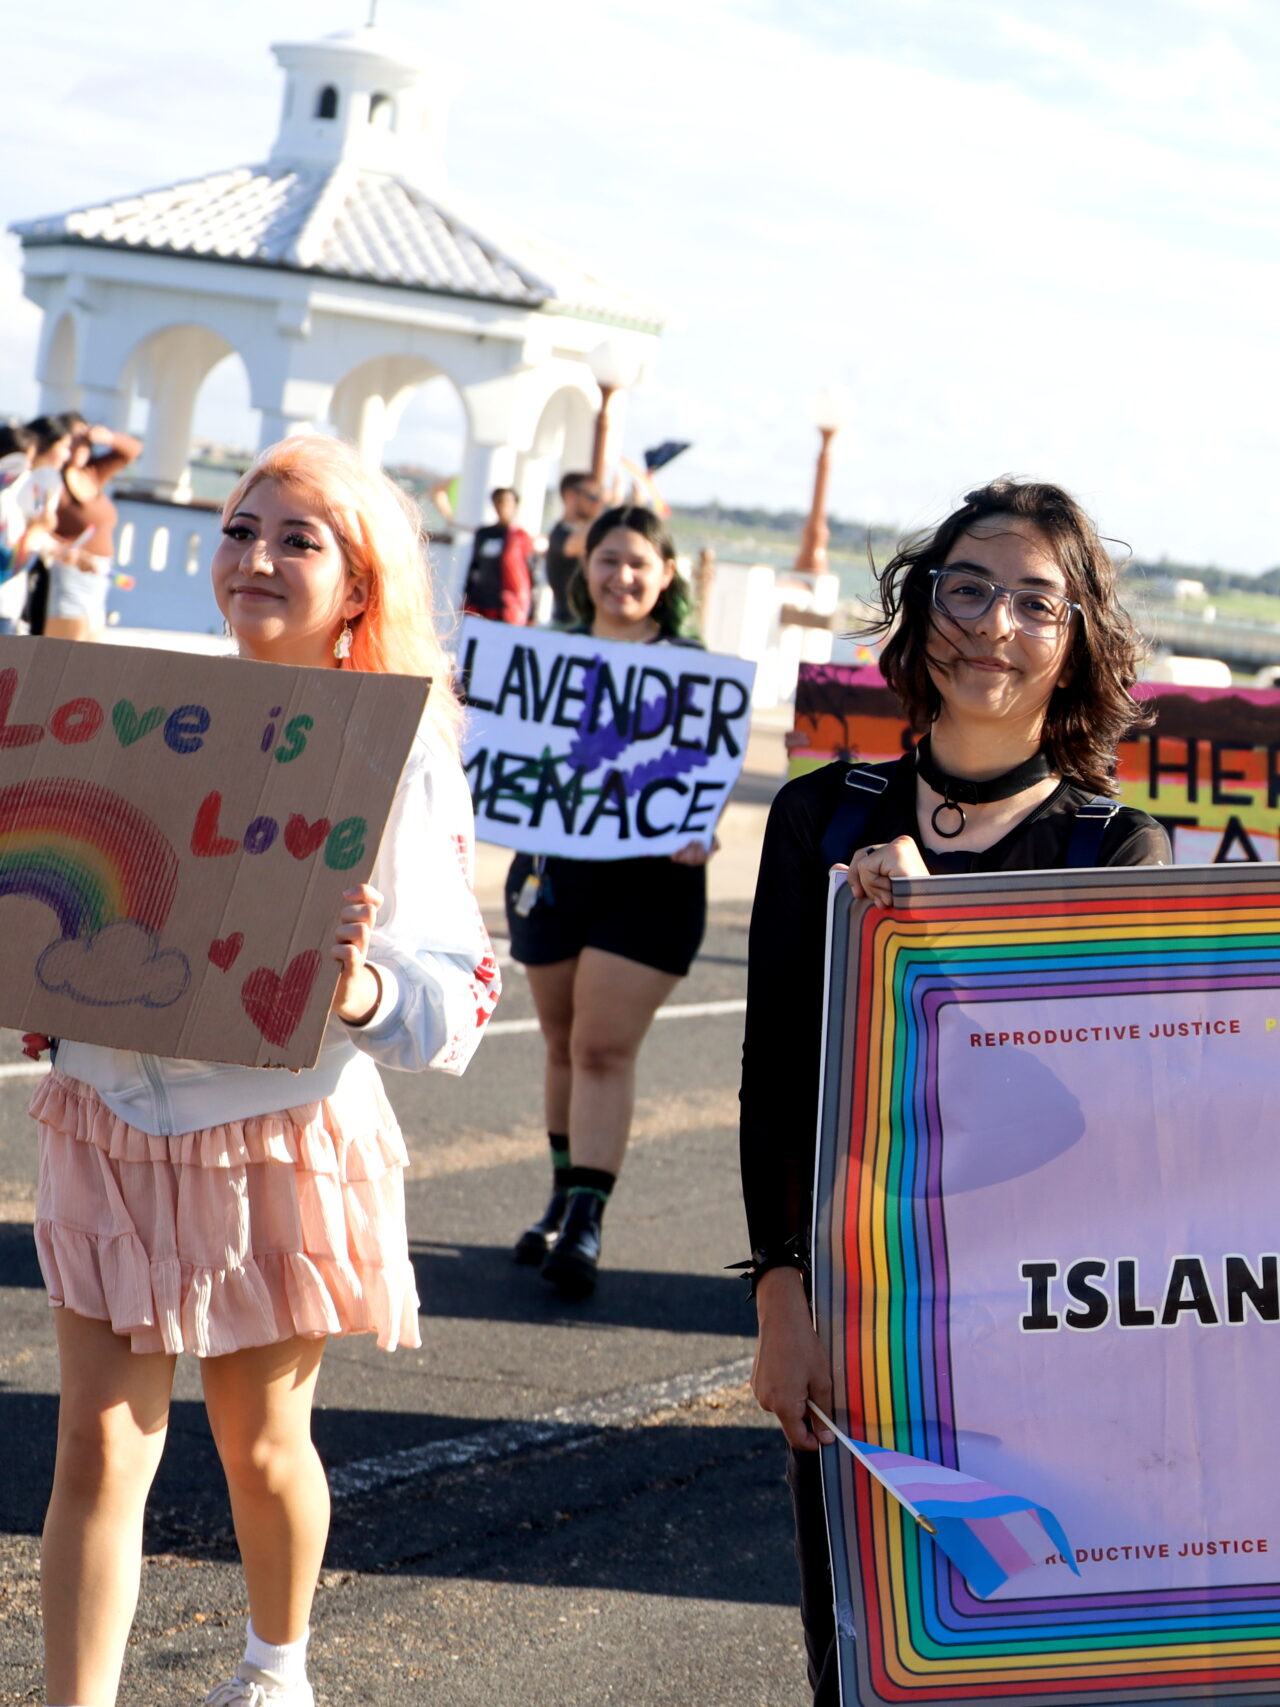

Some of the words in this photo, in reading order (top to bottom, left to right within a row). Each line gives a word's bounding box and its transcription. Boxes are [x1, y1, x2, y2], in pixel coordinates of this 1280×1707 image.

[0, 667, 211, 754] Love
[260, 706, 314, 763] is
[460, 638, 749, 758] LAVENDER
[190, 790, 369, 871] Love
[970, 1025, 1141, 1048] REPRODUCTIVE
[1149, 1019, 1241, 1039] JUSTICE
[1178, 1538, 1269, 1556] JUSTICE
